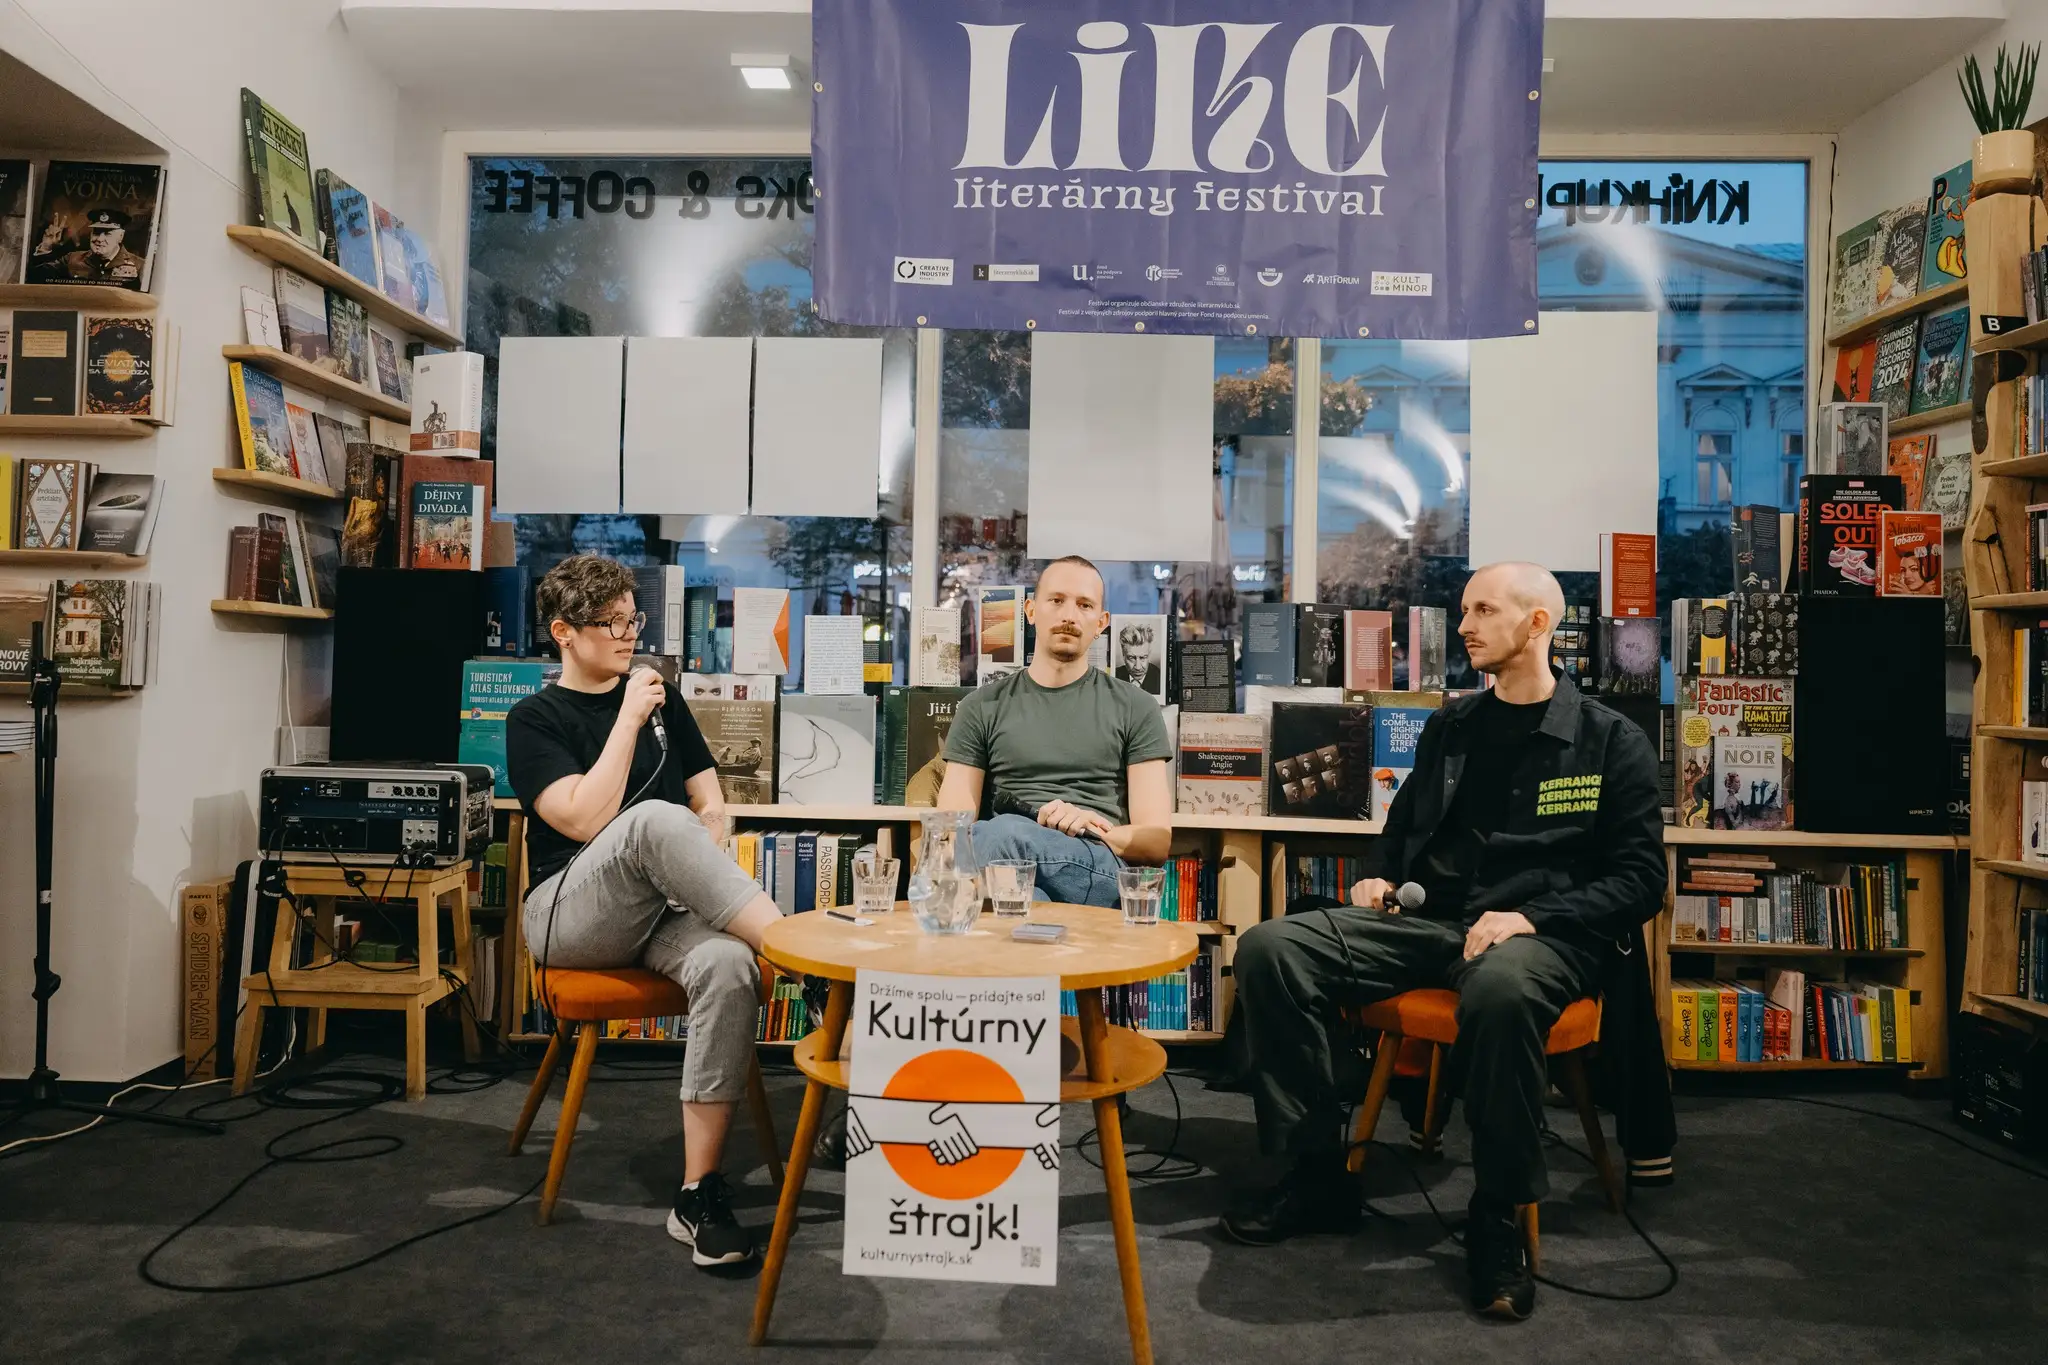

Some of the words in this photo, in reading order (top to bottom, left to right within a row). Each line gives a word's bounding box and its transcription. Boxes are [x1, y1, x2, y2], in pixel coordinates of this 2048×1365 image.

[273, 120, 303, 158] KOČKY
[63, 180, 141, 200] VOJNA
[953, 176, 1176, 218] literárny
[1195, 180, 1386, 217] festival
[919, 264, 950, 272] CREATIVE
[978, 268, 985, 278] k
[1392, 276, 1421, 284] KULT
[1392, 284, 1428, 292] MINOR
[1059, 308, 1080, 316] Festival
[1178, 311, 1200, 319] partner
[1987, 318, 2001, 332] B
[1883, 324, 1914, 343] GUINNESS
[1881, 336, 1912, 356] WORLD
[89, 359, 150, 368] LEVIATAN
[1879, 349, 1911, 369] RECORDS
[1876, 364, 1908, 390] 2024
[424, 488, 463, 501] DĚJINY
[418, 503, 468, 514] DIVADLA
[1800, 497, 1809, 541] SOLED
[1834, 526, 1877, 543] OUT
[1891, 532, 1926, 547] Tobacco
[1800, 545, 1809, 572] OUT
[57, 666, 88, 675] slovenské
[470, 671, 513, 683] TURISTICKÝ
[469, 683, 493, 694] ATLAS
[494, 684, 536, 695] SLOVENSKA
[1697, 680, 1784, 703] Fantastic
[488, 696, 503, 704] ATLAS
[926, 702, 952, 717] Jiří
[1390, 712, 1407, 720] THE
[1381, 719, 1425, 727] COMPLETE
[1390, 732, 1415, 740] GUIDE
[1197, 752, 1247, 763] Shakespearova
[1210, 760, 1233, 769] Anglie
[1724, 749, 1776, 765] NOIR
[819, 845, 832, 907] PASSWORD
[189, 932, 211, 1041] SPIDER-MAN
[870, 982, 914, 999] Držíme
[917, 987, 953, 1002] spolu
[969, 989, 1025, 1005] pridajte
[1027, 989, 1046, 1002] sa!
[868, 999, 1047, 1055] Kultúrny
[1882, 1025, 1895, 1044] 365
[888, 1197, 1020, 1251] štrajk!
[860, 1247, 974, 1269] kulturnystrajk.sk
